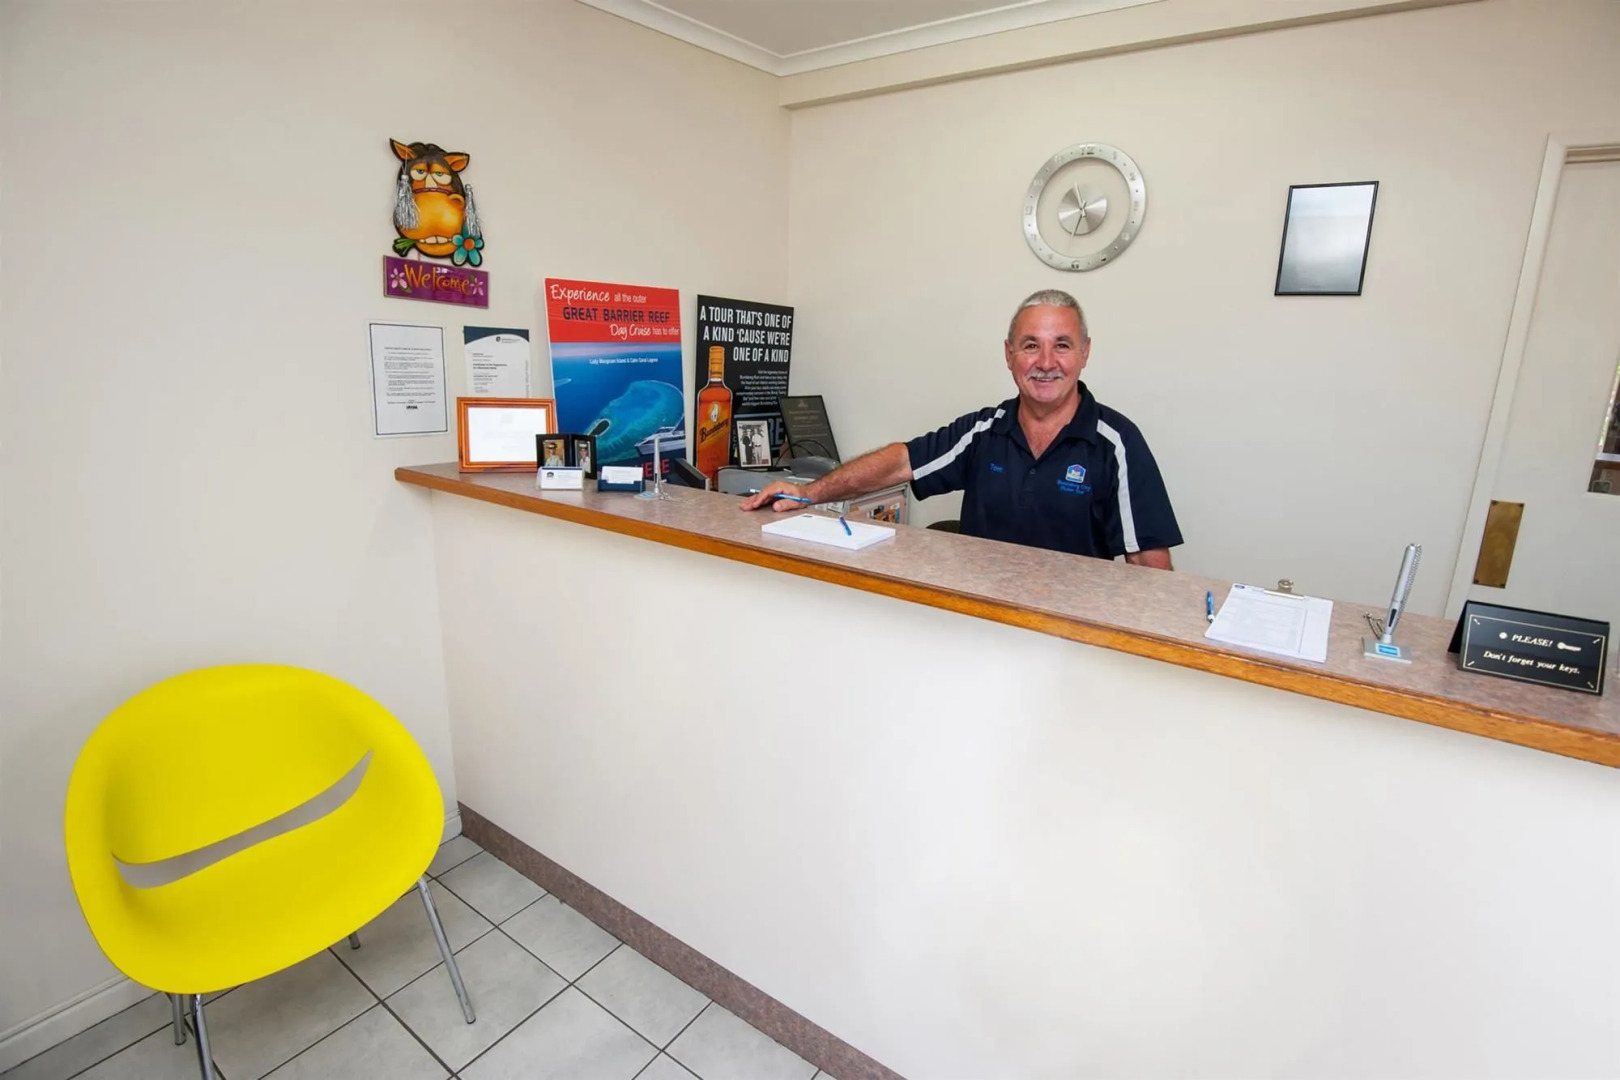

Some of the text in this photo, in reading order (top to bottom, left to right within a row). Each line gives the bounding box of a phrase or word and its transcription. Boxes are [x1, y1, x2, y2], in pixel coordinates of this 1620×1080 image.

[404, 264, 470, 295] Welcome
[550, 284, 610, 305] Experience
[622, 293, 632, 302] the
[632, 295, 647, 303] outer
[563, 306, 670, 323] GREAT BARRIER REEF
[700, 305, 792, 329] A TOUR THAT'S ONE OF
[609, 324, 628, 340] Day
[629, 324, 651, 336] Cruise
[652, 326, 662, 335] has
[668, 327, 680, 335] offer
[703, 325, 709, 340] A
[712, 326, 734, 342] KIND
[767, 331, 790, 346] WE'RE
[733, 346, 789, 362] ONE OF A KIND
[1511, 634, 1554, 648] PLEASE!
[1483, 650, 1580, 674] Don't forget your keys.
